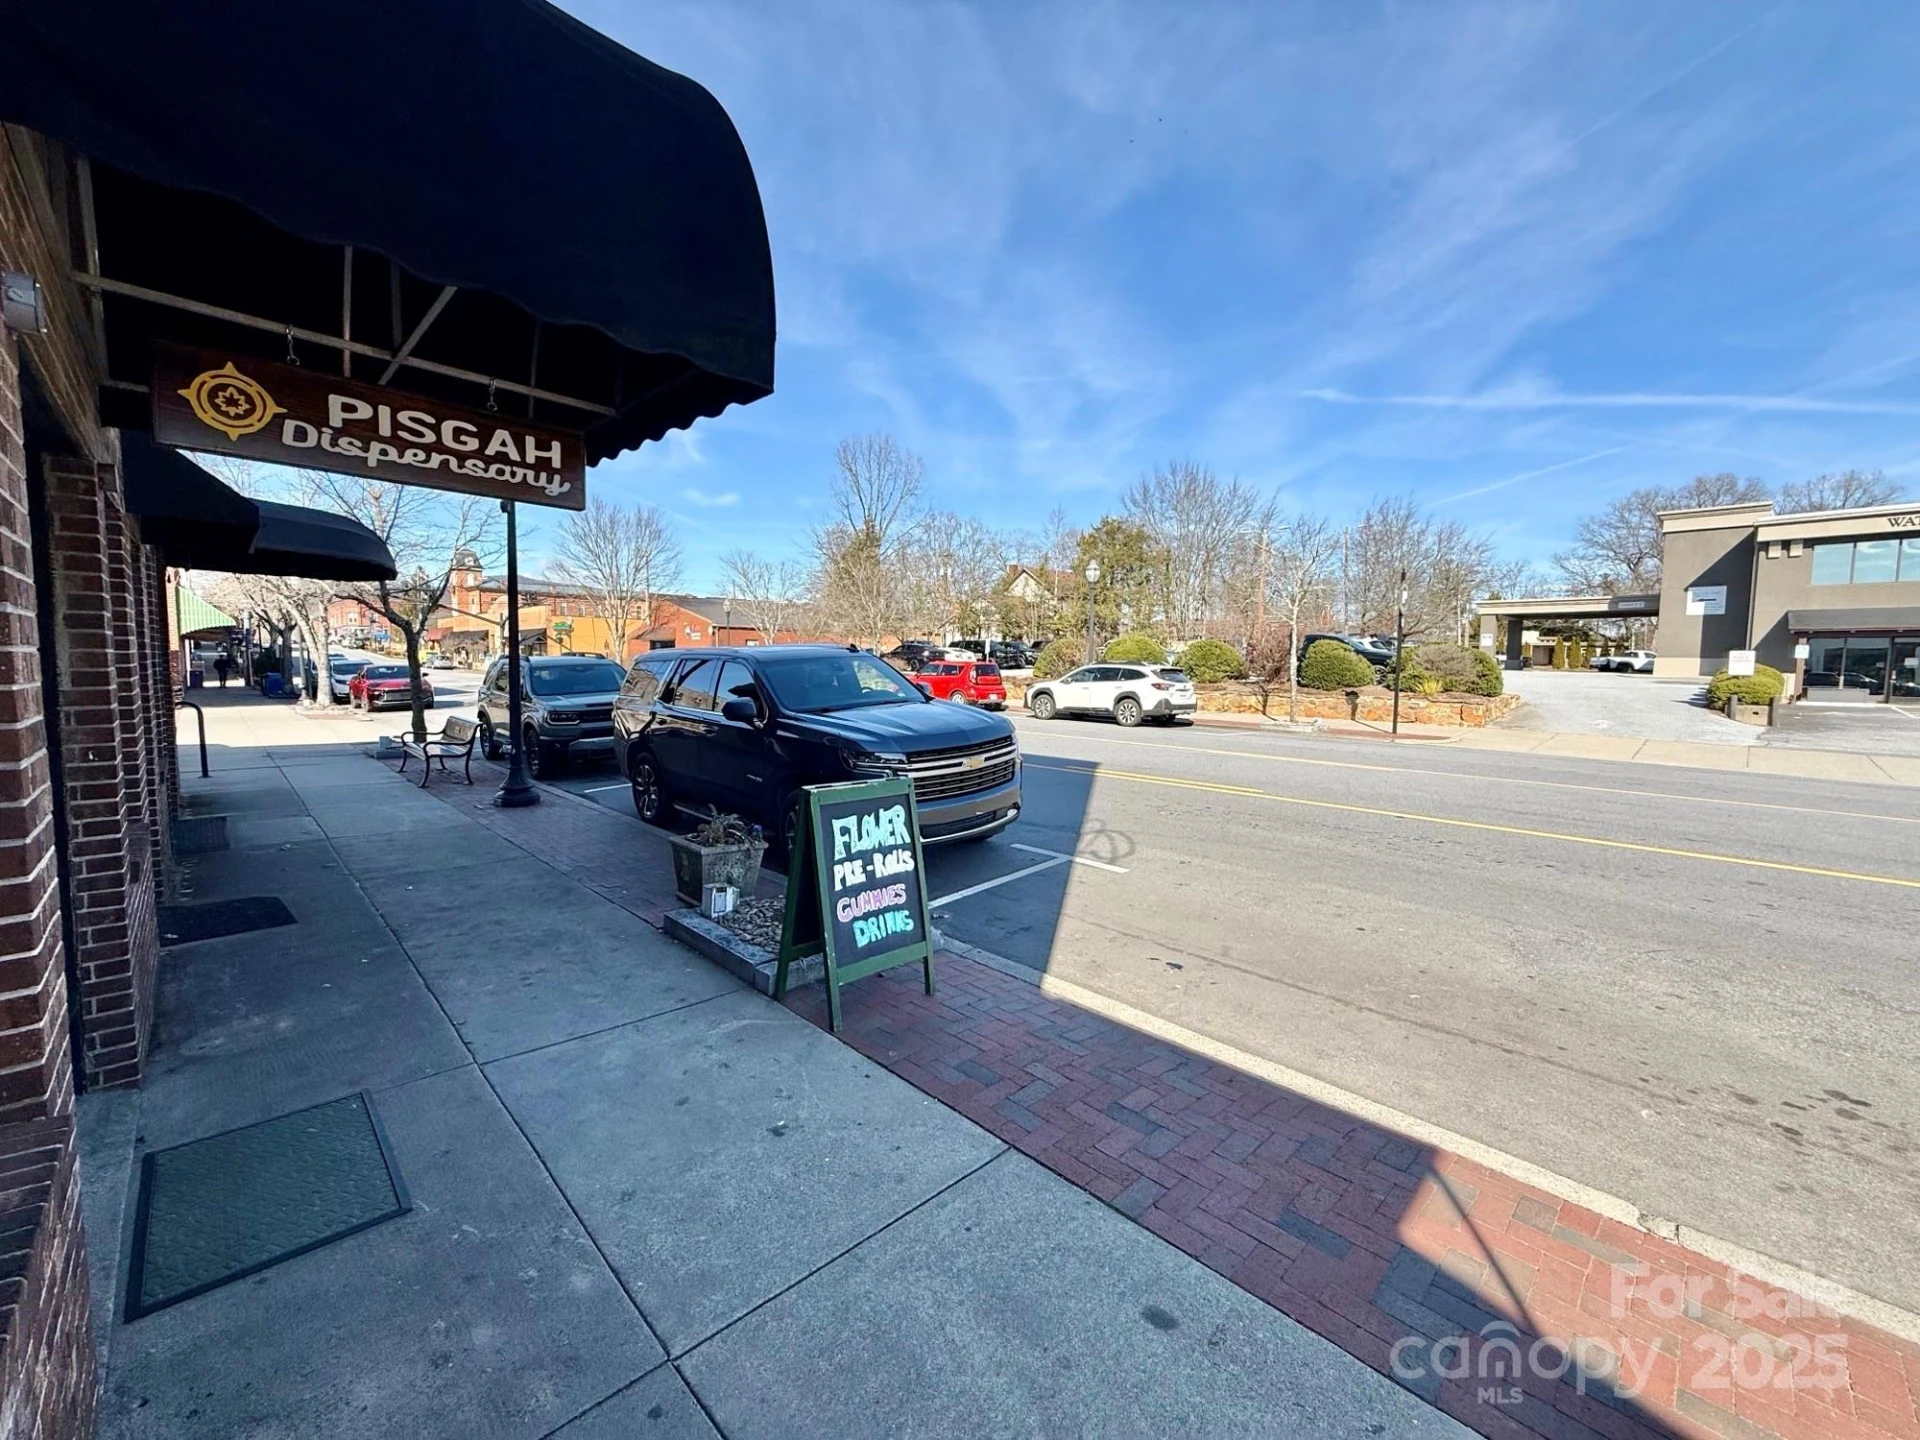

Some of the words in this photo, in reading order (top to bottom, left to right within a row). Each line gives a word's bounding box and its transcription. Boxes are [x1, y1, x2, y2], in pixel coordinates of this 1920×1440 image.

[282, 420, 571, 496] Dispensary
[329, 394, 562, 469] PISGAH
[832, 804, 911, 861] FLOWER
[836, 883, 907, 922] GUMMIES
[853, 910, 914, 948] DRINKS
